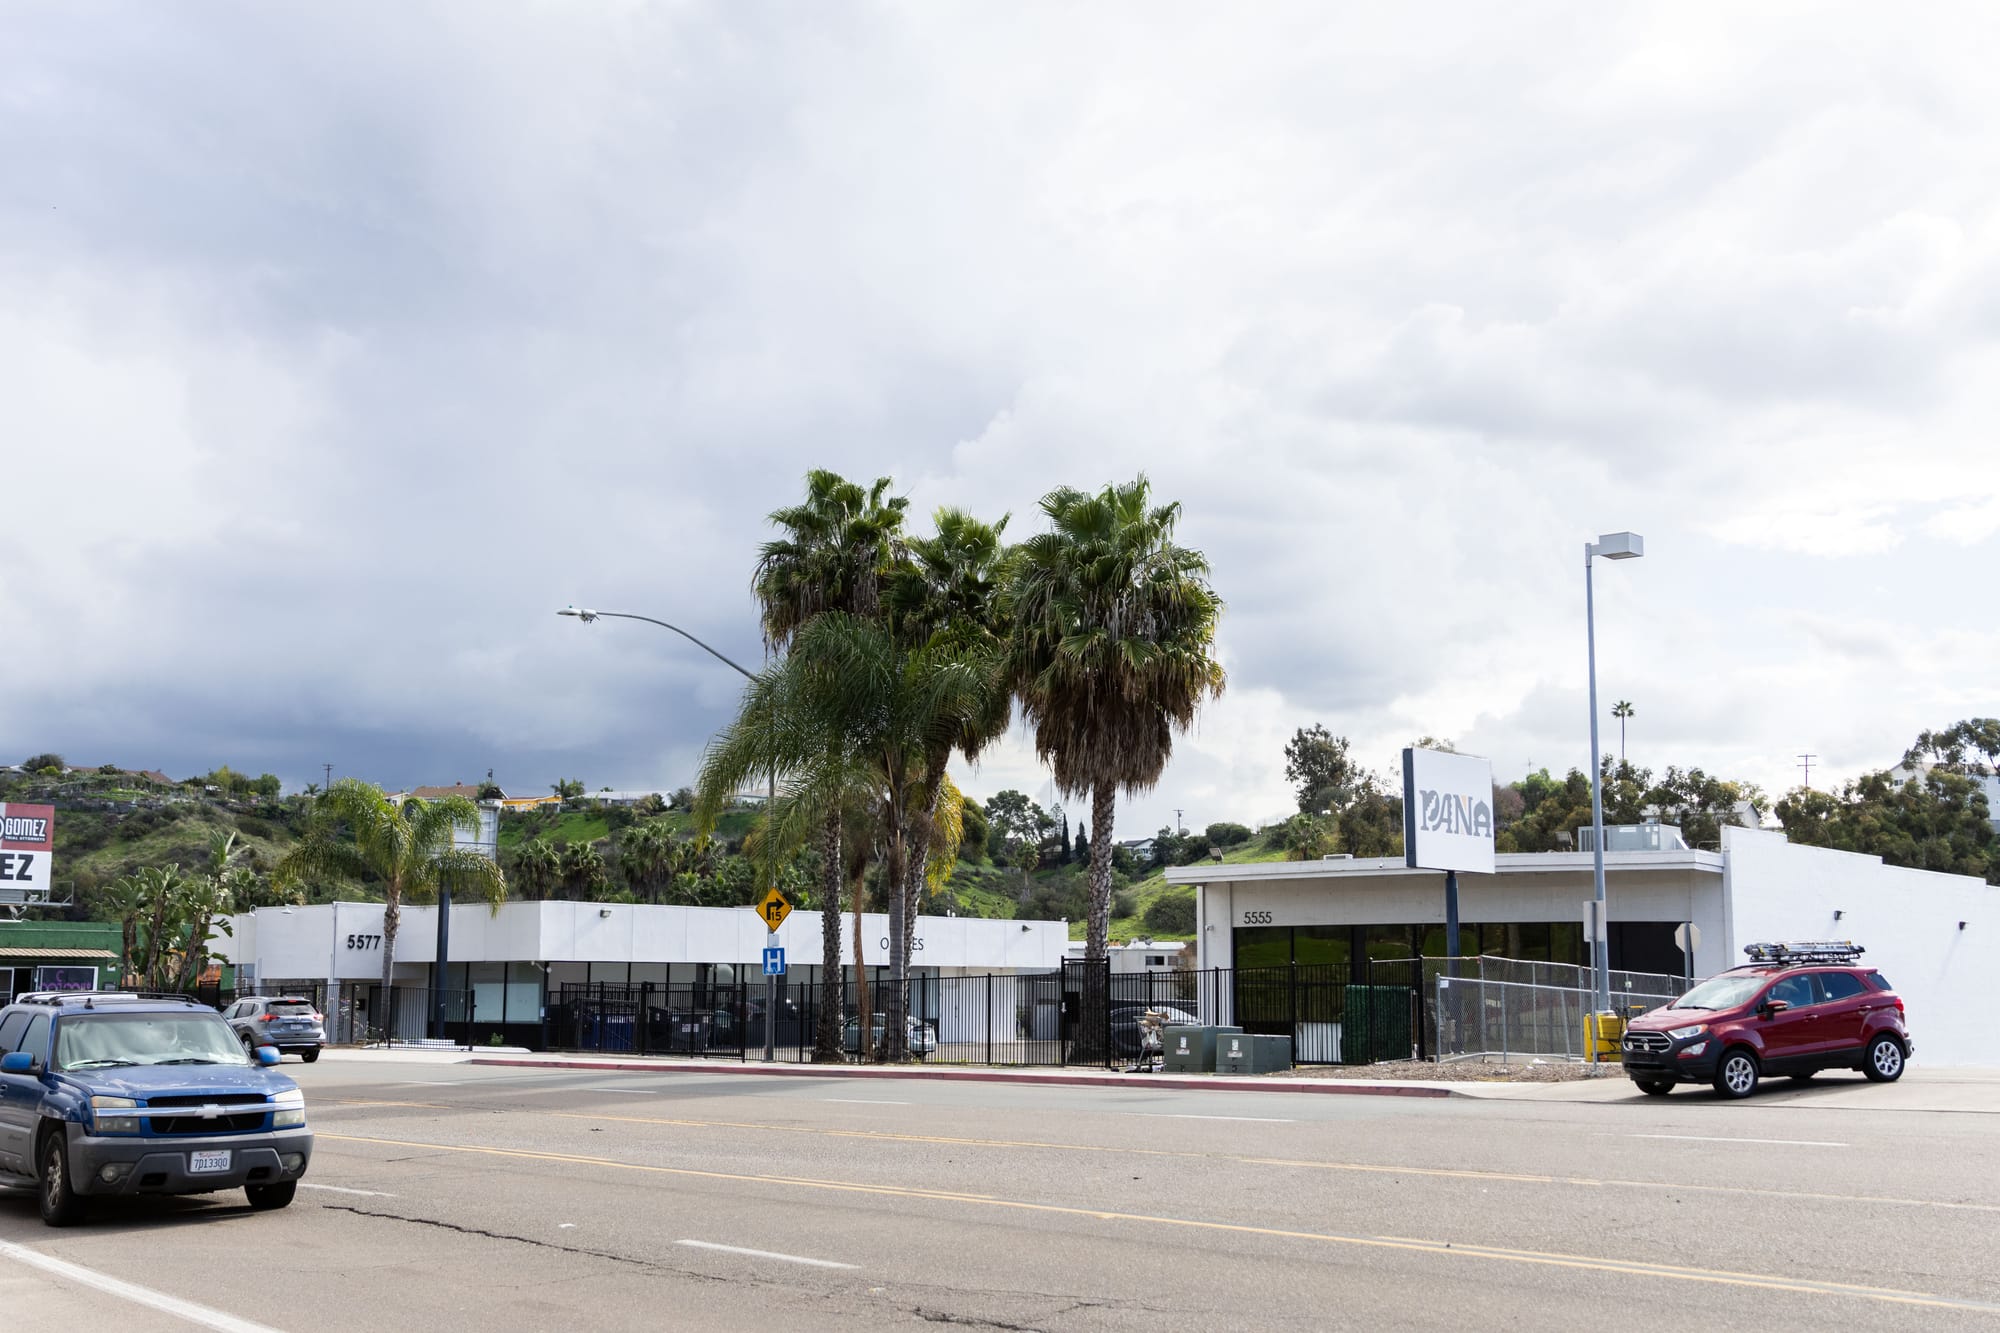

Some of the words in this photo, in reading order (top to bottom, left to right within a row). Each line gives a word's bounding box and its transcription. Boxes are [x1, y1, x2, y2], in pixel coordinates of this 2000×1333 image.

[1419, 790, 1492, 838] PANA
[5, 817, 47, 837] GOMEZ
[771, 911, 782, 921] 15
[1243, 911, 1272, 924] 5555
[347, 934, 381, 950] 5577
[766, 950, 781, 972] H
